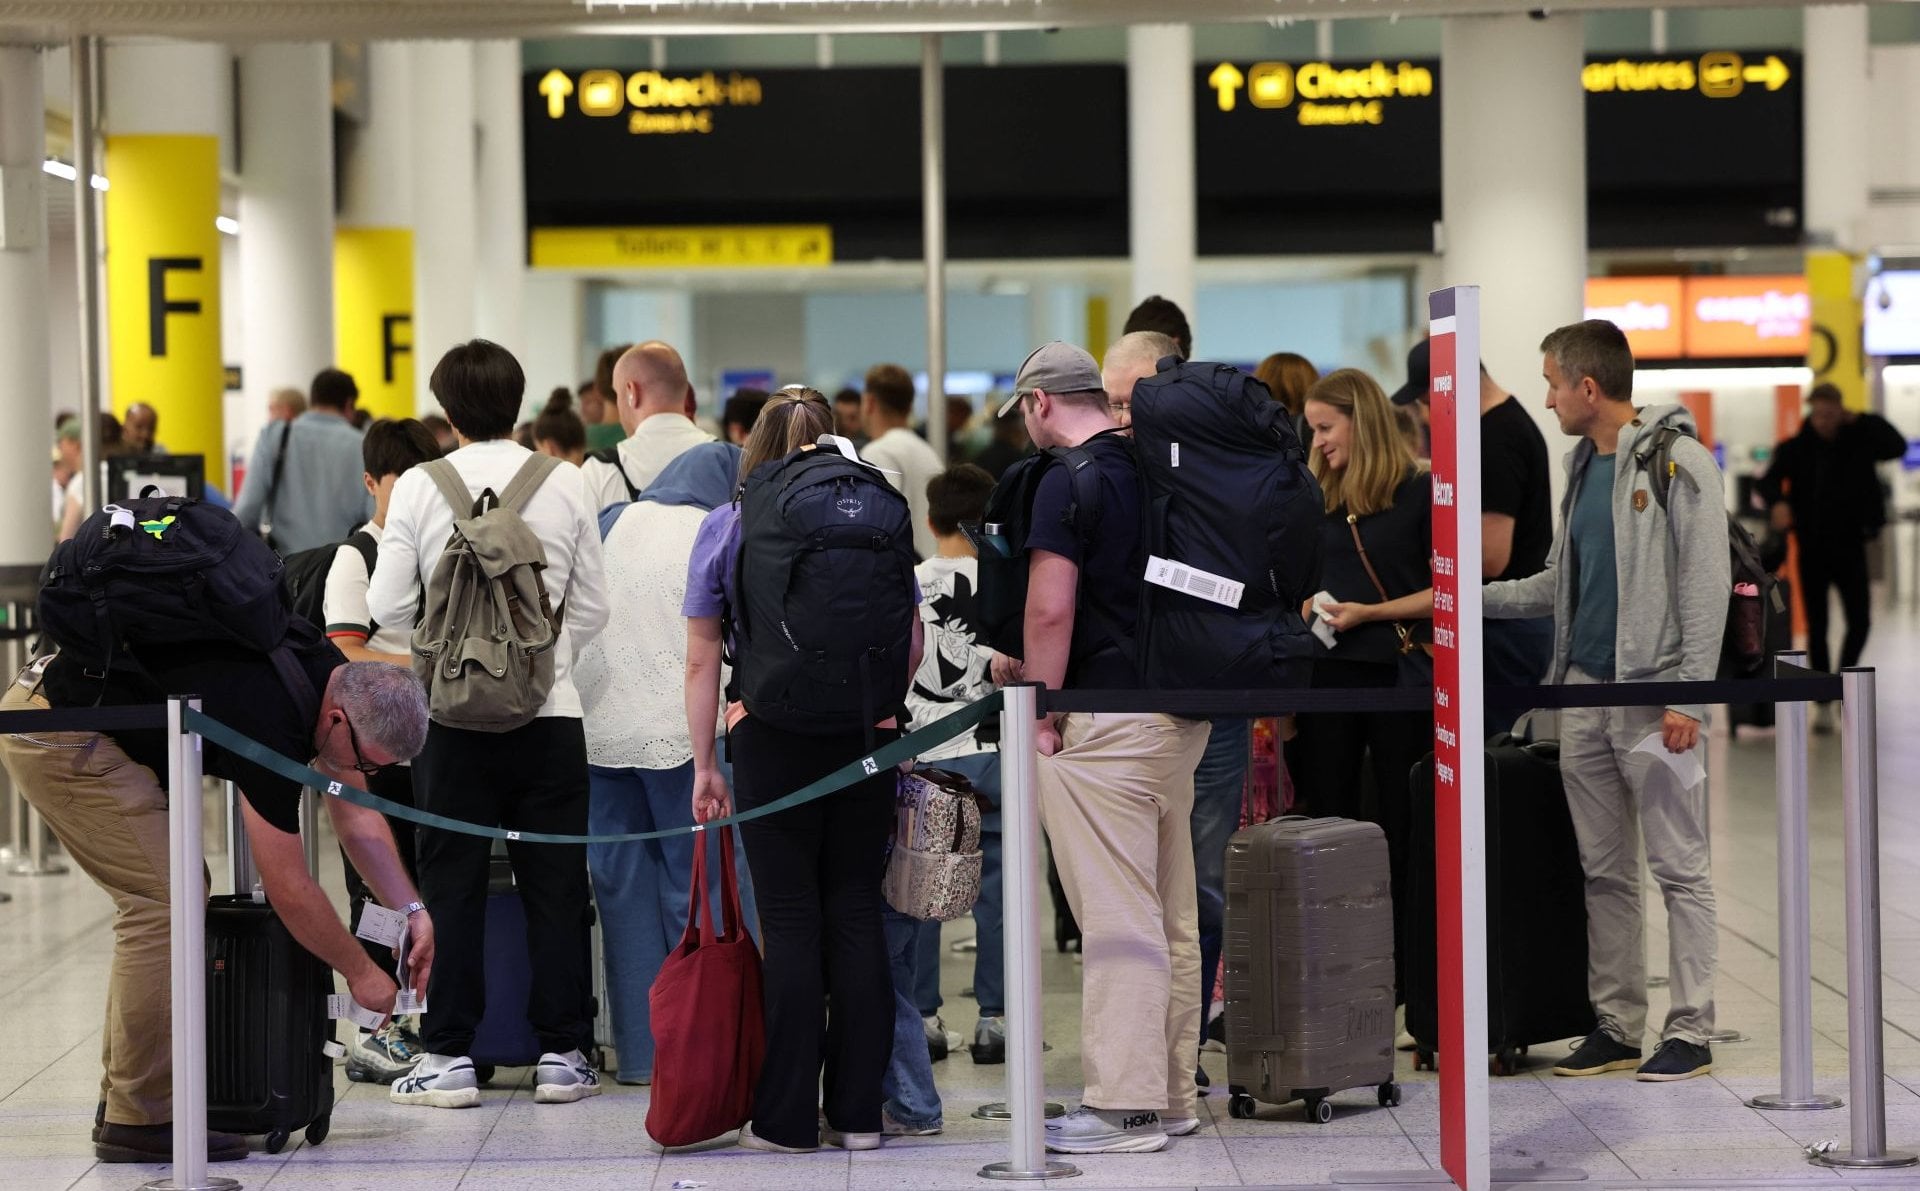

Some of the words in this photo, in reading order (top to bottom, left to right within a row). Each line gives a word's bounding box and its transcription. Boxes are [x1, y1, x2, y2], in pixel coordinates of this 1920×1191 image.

[148, 256, 203, 358] F
[381, 313, 413, 384] F
[1432, 473, 1454, 507] Welcome
[1123, 1111, 1159, 1130] HOKA
